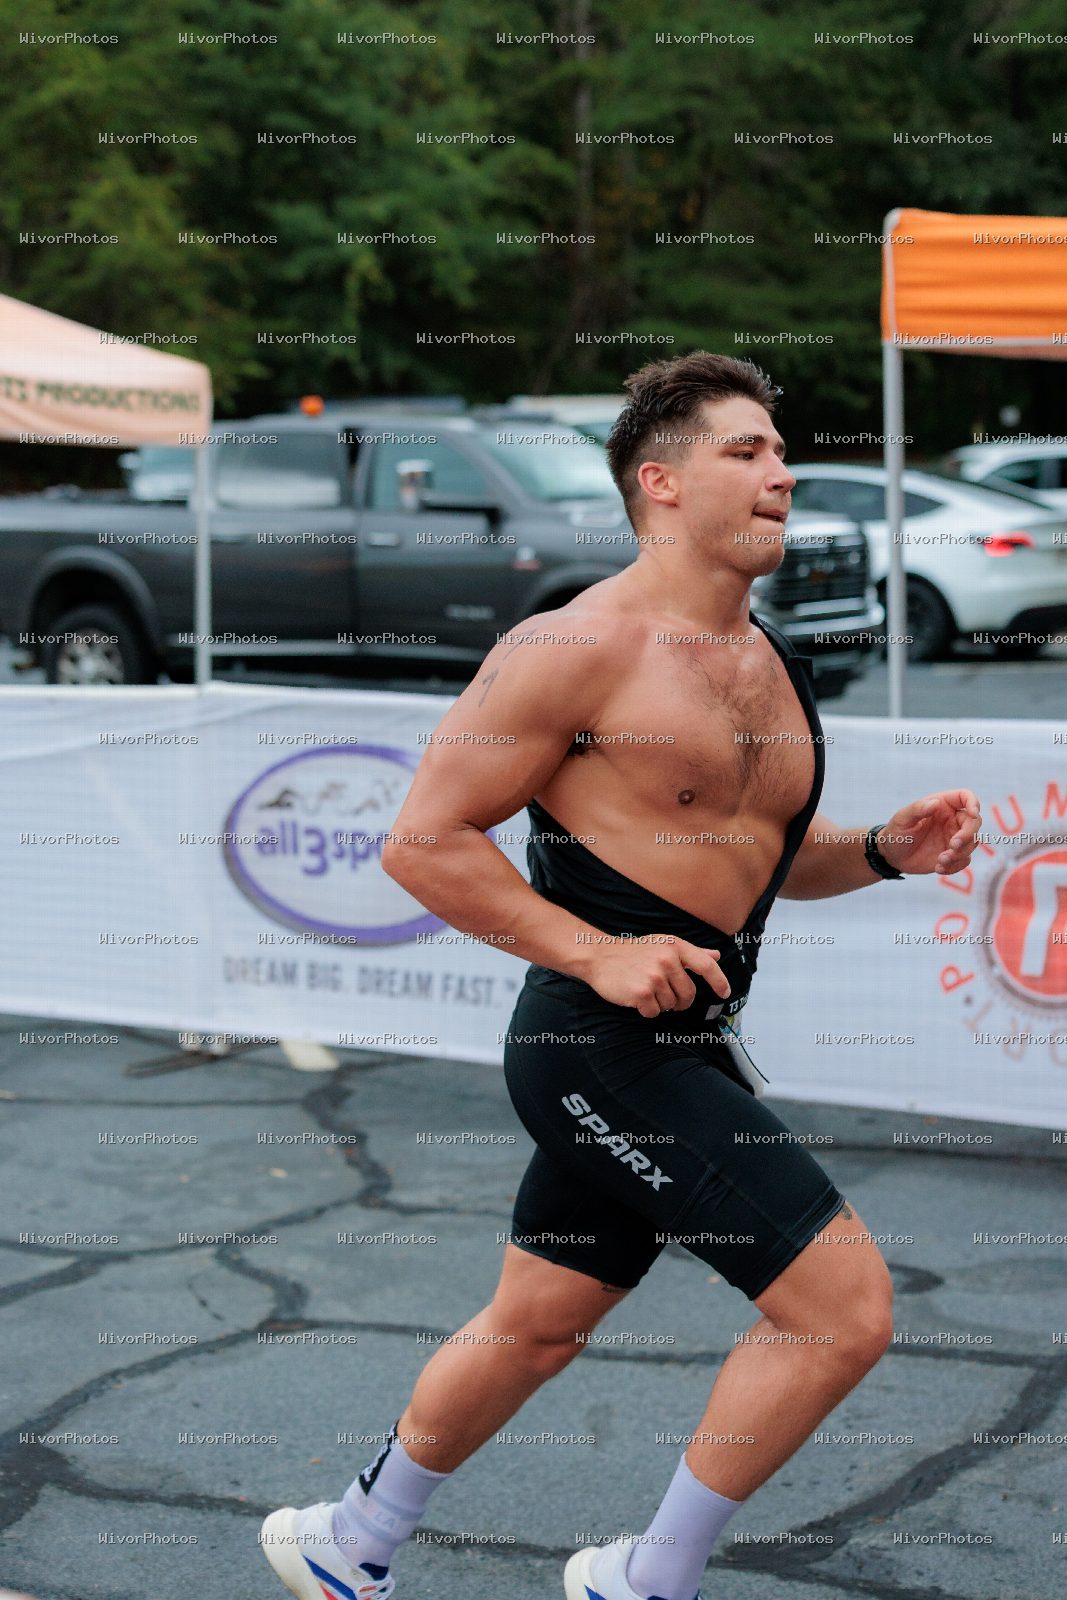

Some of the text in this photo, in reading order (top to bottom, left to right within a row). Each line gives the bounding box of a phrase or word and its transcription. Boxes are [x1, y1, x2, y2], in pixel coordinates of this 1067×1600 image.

[37, 380, 200, 412] PRODUCTIONS
[222, 955, 299, 987] DREAM
[357, 964, 433, 1000] DREAM
[561, 1093, 674, 1192] SPARX
